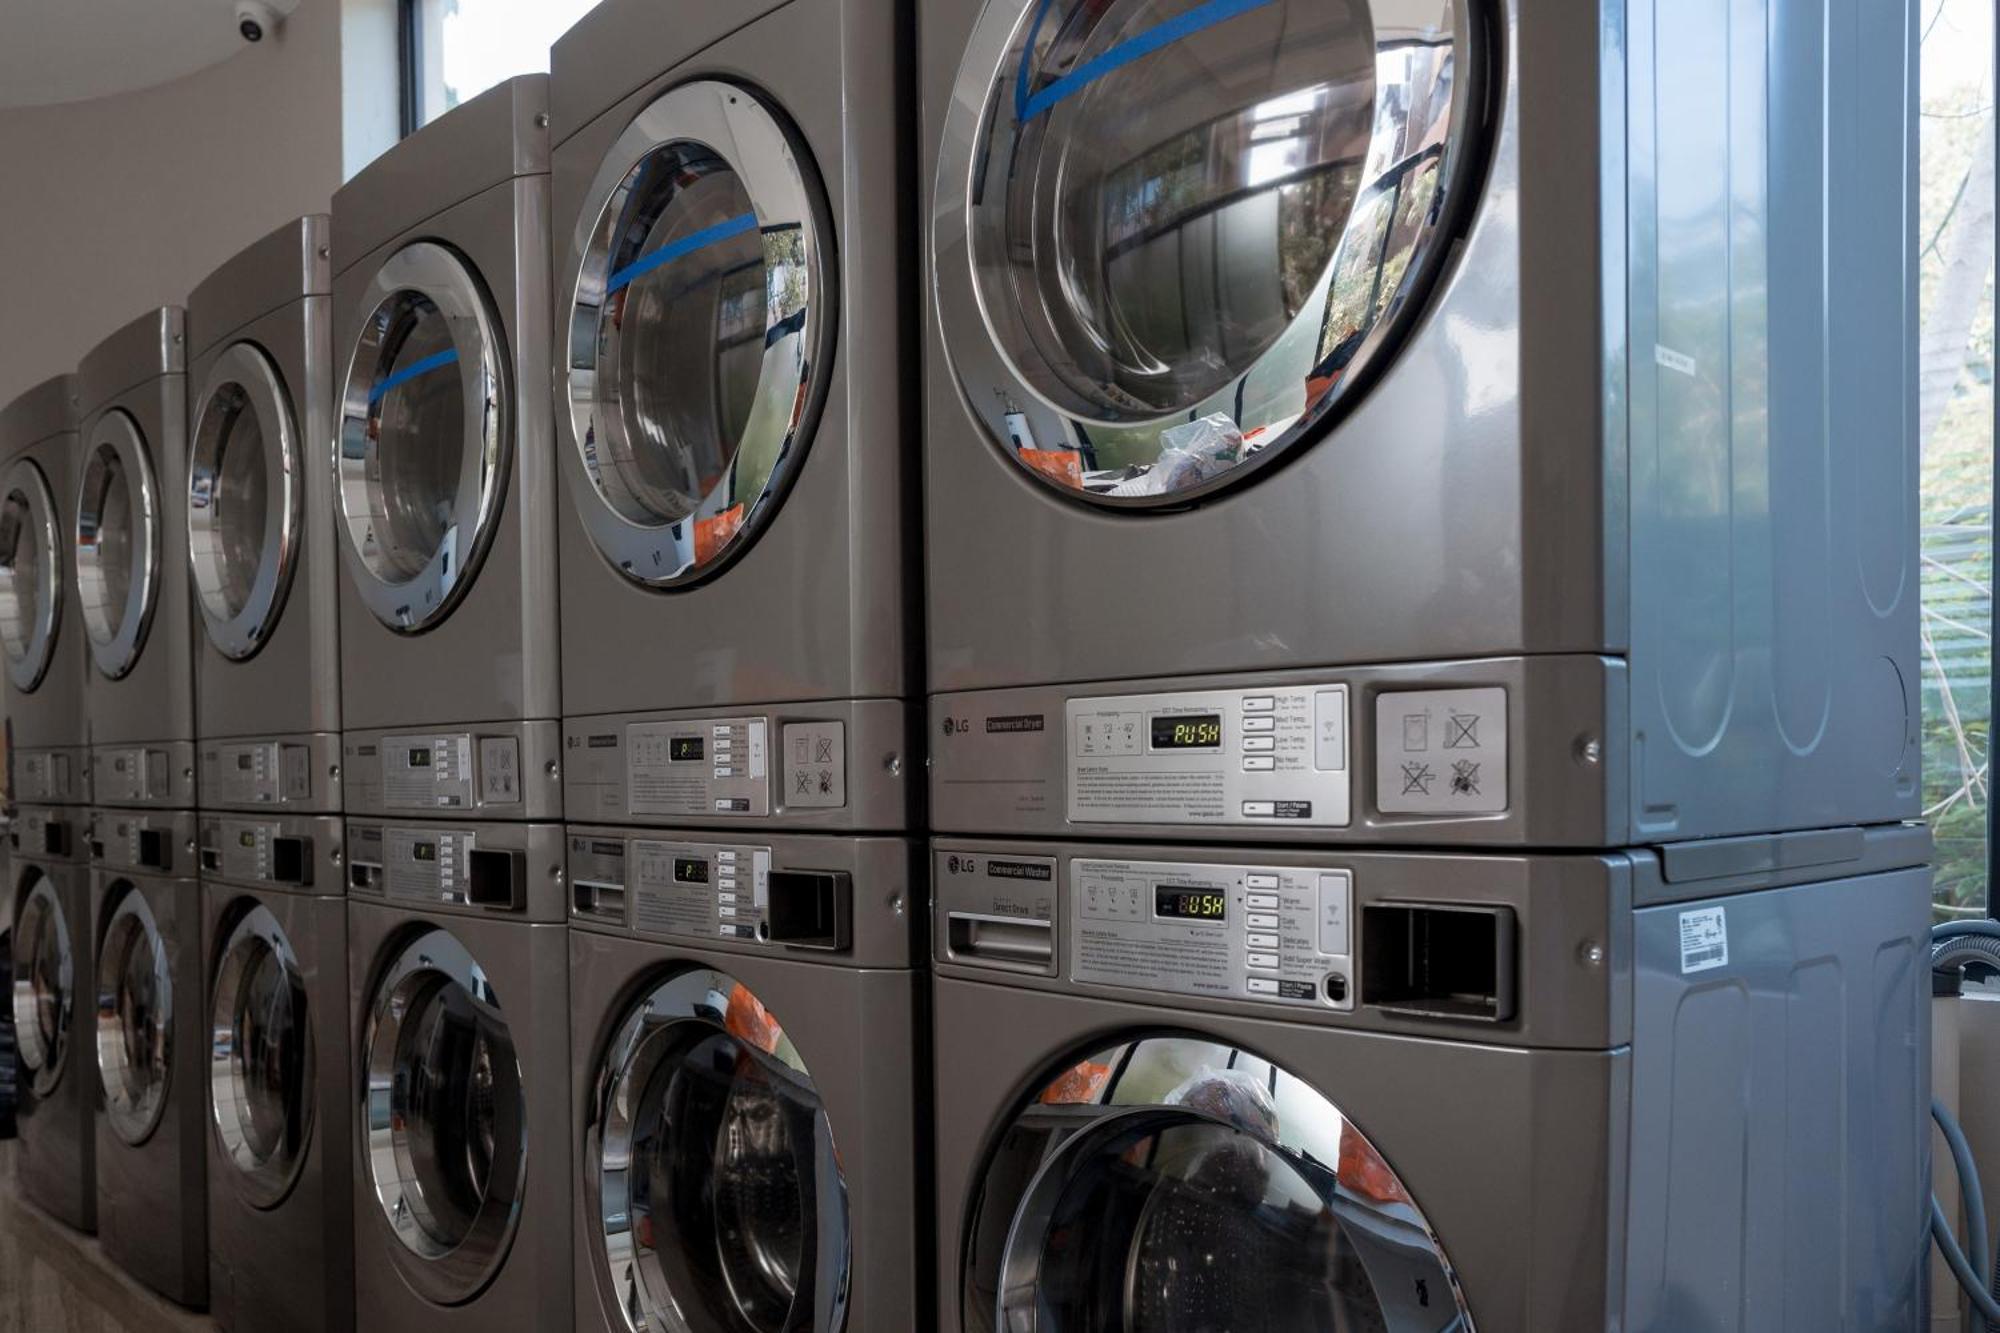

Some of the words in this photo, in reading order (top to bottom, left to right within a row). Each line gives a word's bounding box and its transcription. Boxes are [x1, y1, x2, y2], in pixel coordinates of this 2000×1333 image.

[987, 718, 1023, 731] Commercial
[1024, 717, 1043, 731] Dryer
[1174, 723, 1219, 743] PUSH
[989, 864, 1025, 876] Commercial
[1025, 866, 1050, 879] Washer
[993, 902, 1012, 913] Direct
[1013, 904, 1029, 914] Drive
